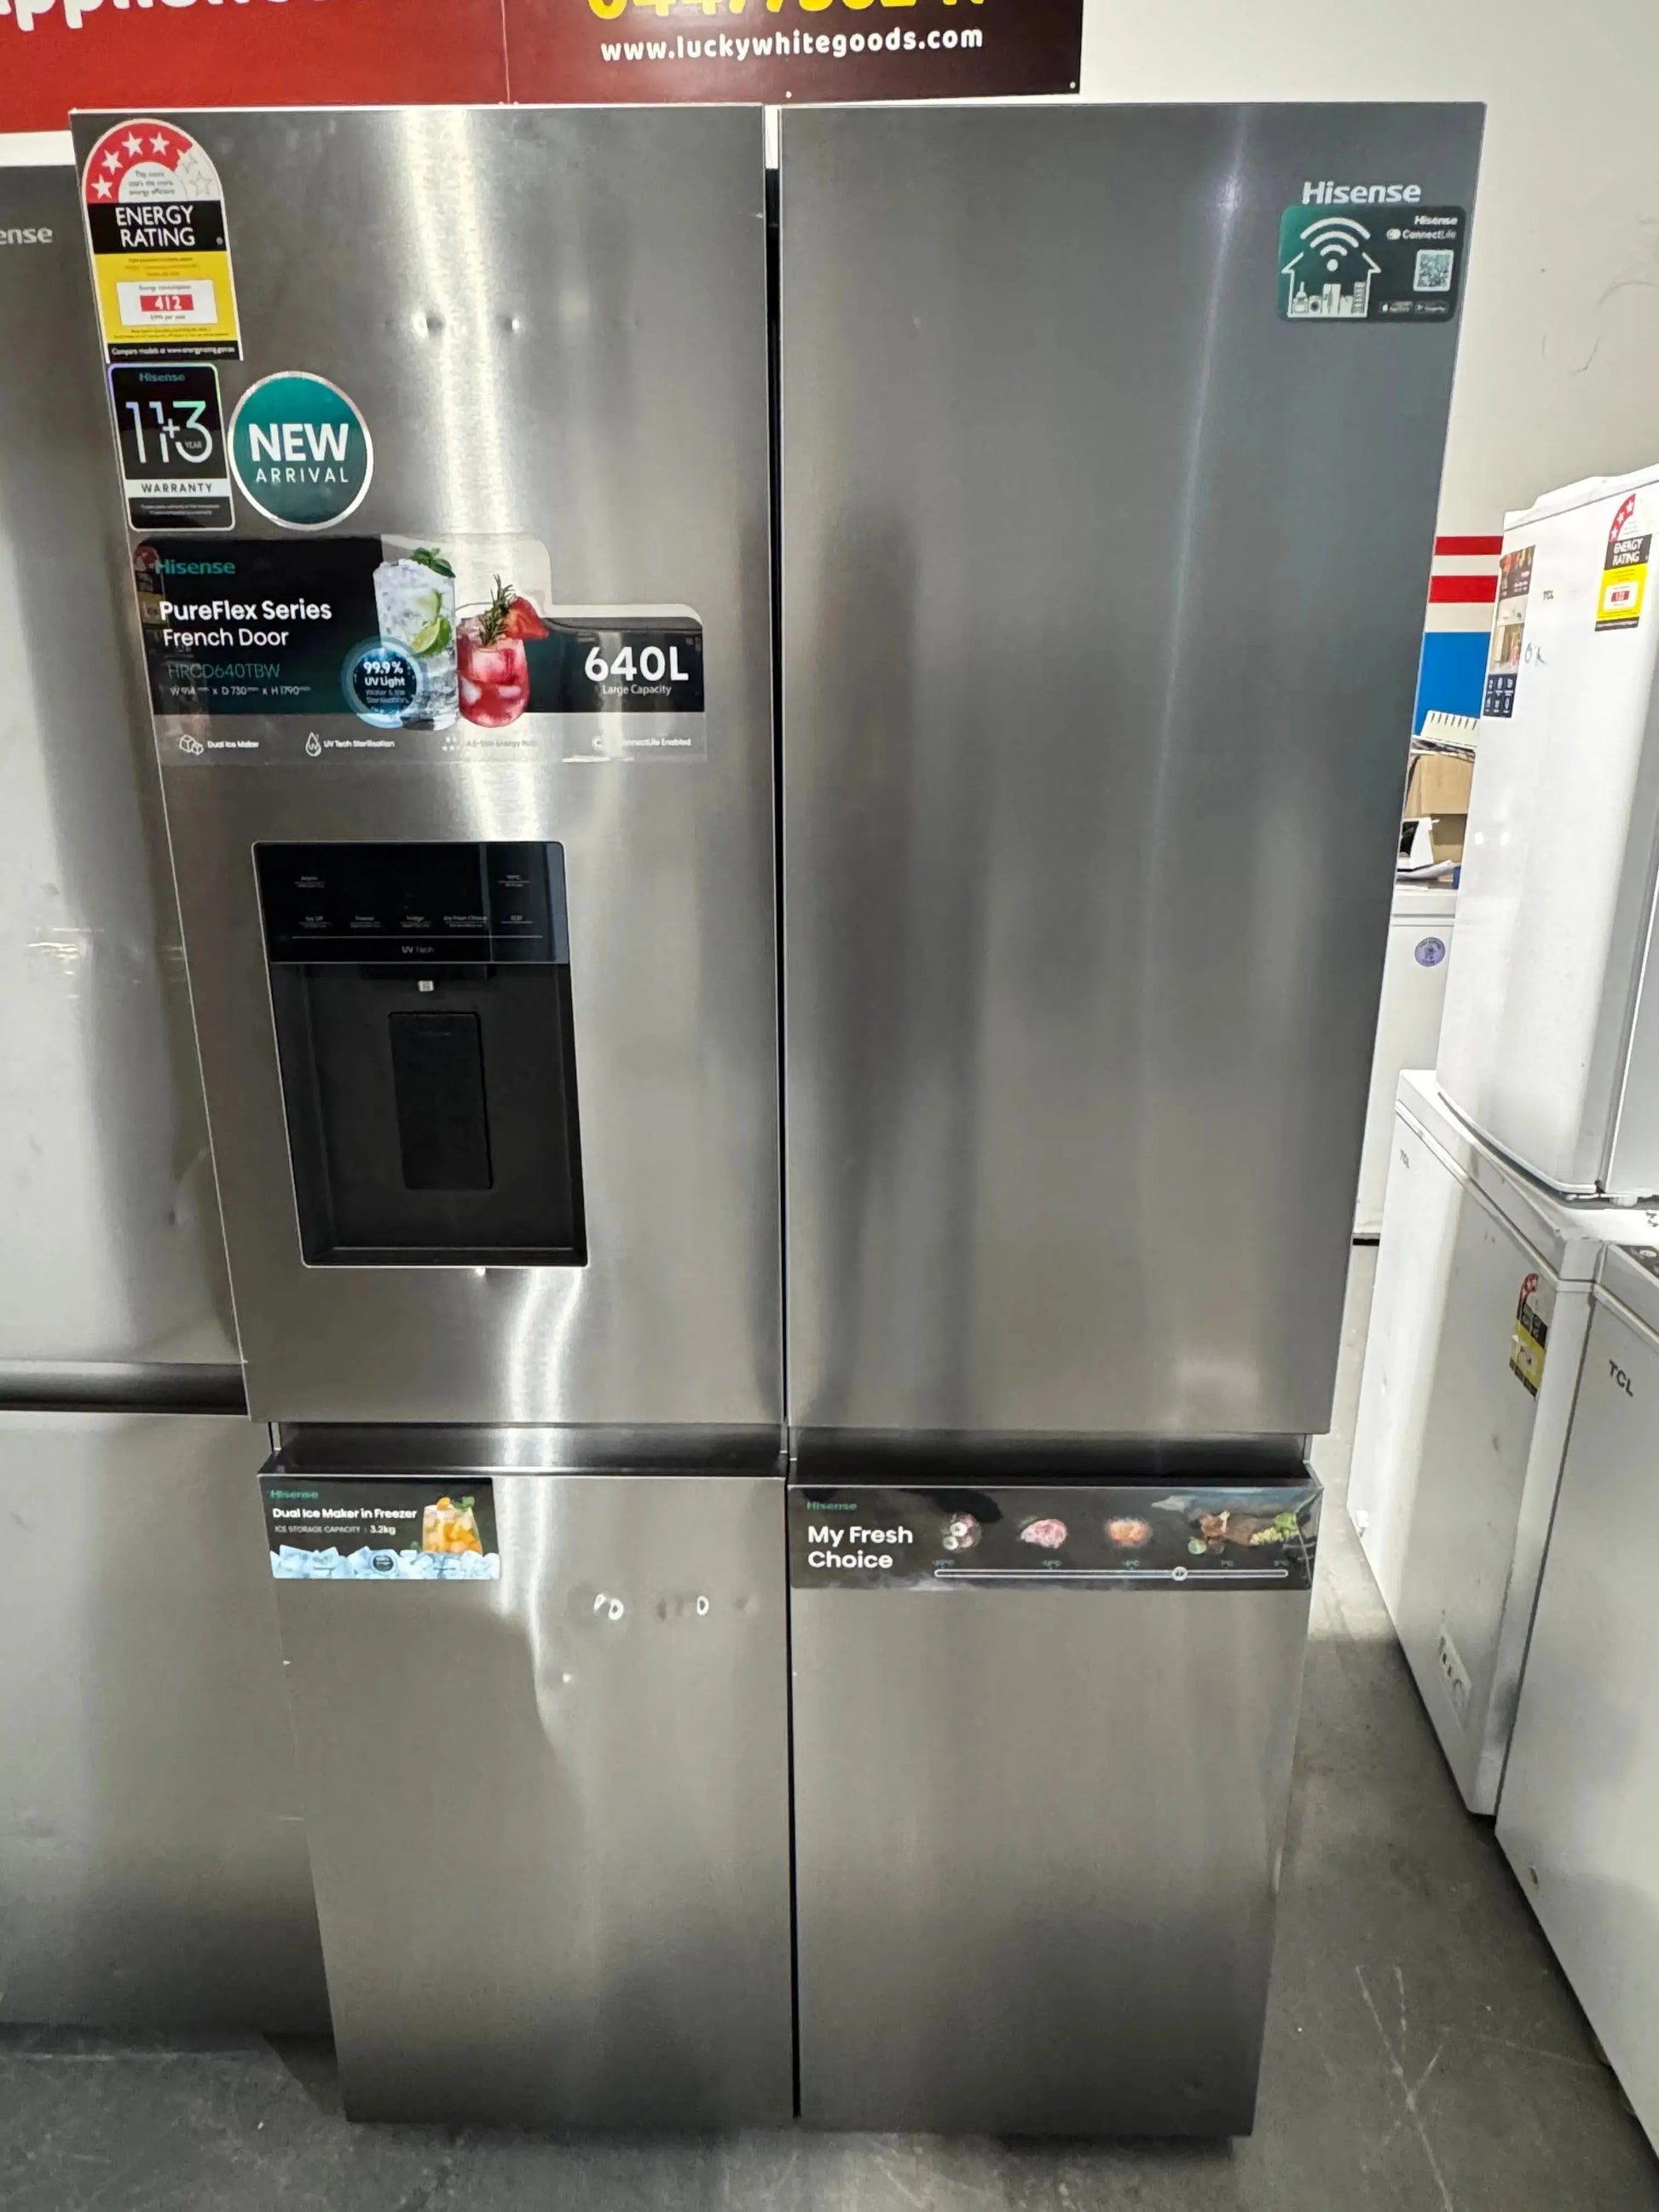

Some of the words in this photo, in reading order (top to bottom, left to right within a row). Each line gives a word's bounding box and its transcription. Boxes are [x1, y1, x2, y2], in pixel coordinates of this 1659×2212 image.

[601, 27, 983, 62] www.luckywhitegoods.com
[1302, 181, 1421, 205] Hisense
[115, 205, 194, 226] ENERGY
[120, 228, 195, 247] RATING
[154, 295, 182, 310] 412
[139, 372, 186, 382] Hisense
[184, 440, 203, 449] YEAR
[248, 423, 350, 462] NEW
[256, 466, 349, 483] ARRIVAL
[141, 482, 212, 493] WARRANTY
[154, 558, 236, 575] Hisense
[159, 599, 258, 621] PureFlex
[261, 598, 332, 620] Series
[163, 627, 234, 647] French
[238, 627, 290, 646] Door
[168, 662, 281, 679] HRCD640TBW
[584, 645, 690, 682] 640L
[364, 677, 379, 686] UV
[380, 675, 406, 688] Light
[602, 684, 630, 696] Large
[631, 684, 672, 696] Capacity
[323, 740, 333, 748] UV
[402, 945, 413, 954] UV
[1609, 1358, 1634, 1398] TCL
[272, 1507, 300, 1519] Dual
[302, 1509, 321, 1519] Ice
[322, 1508, 359, 1519] Maker
[361, 1507, 373, 1519] in
[373, 1508, 418, 1520] Freezer
[275, 1525, 287, 1533] ICE
[288, 1525, 323, 1533] STORAGE
[324, 1525, 361, 1533] CAPACITY
[370, 1524, 396, 1536] 3.2kg
[807, 1525, 845, 1548] My
[849, 1525, 914, 1545] Fresh
[807, 1550, 893, 1569] Choice
